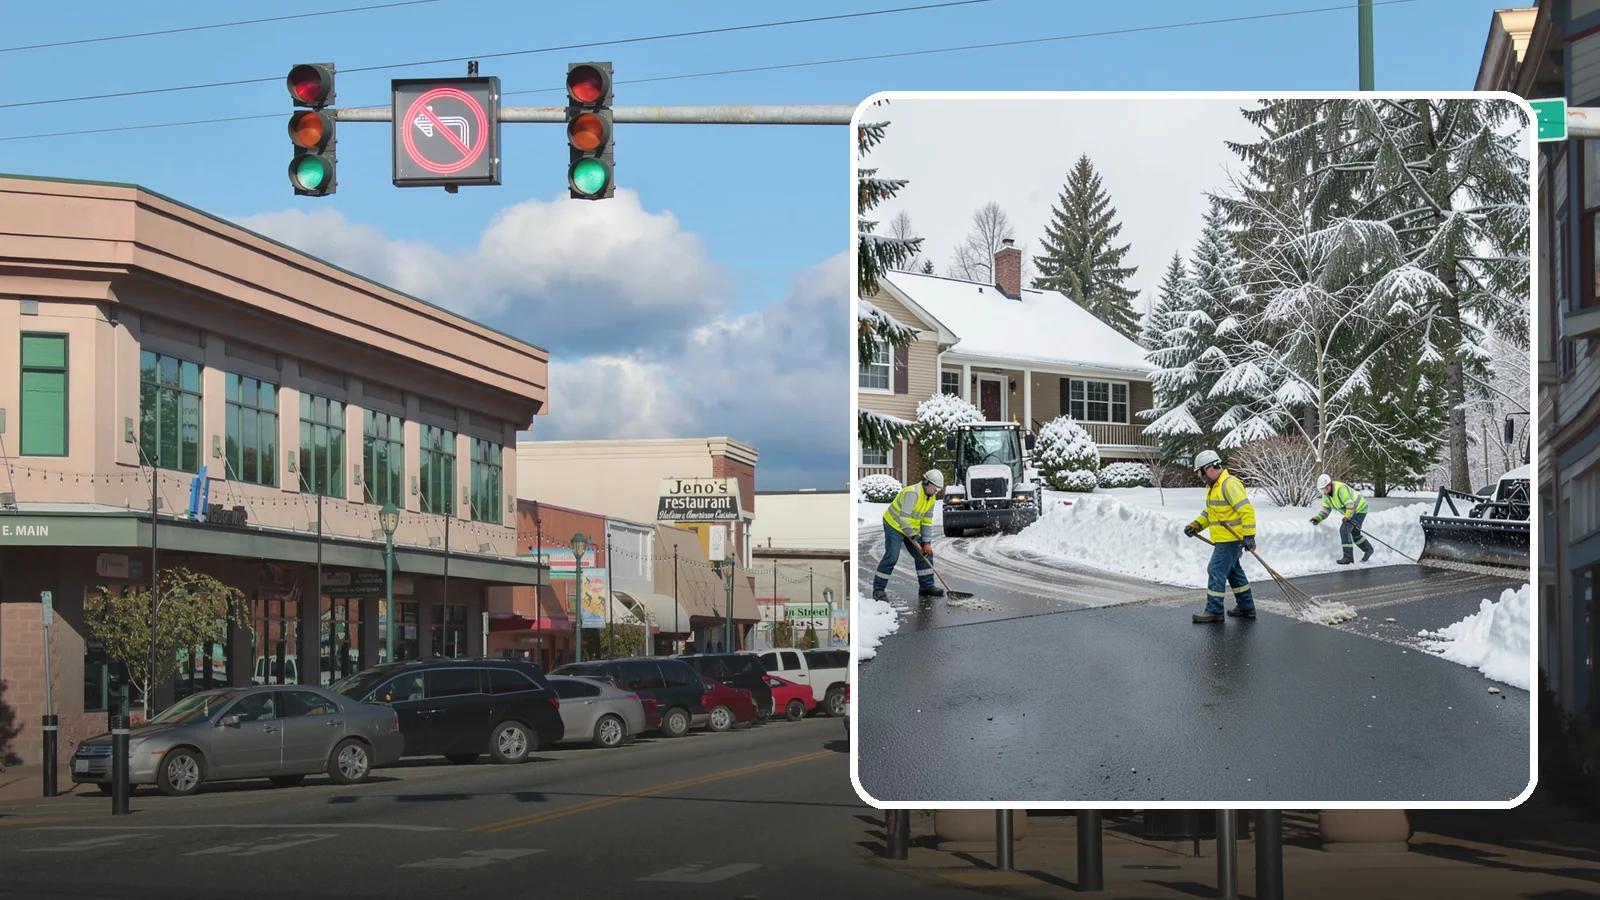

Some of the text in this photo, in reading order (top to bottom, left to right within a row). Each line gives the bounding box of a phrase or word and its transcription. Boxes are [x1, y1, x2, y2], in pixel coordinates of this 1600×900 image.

[670, 480, 727, 494] Jeno's
[665, 496, 731, 509] restaurant
[659, 510, 681, 519] Italian
[686, 509, 715, 519] American
[715, 509, 737, 519] Cuisine
[2, 525, 49, 536] E. MAIN
[797, 607, 828, 616] Street
